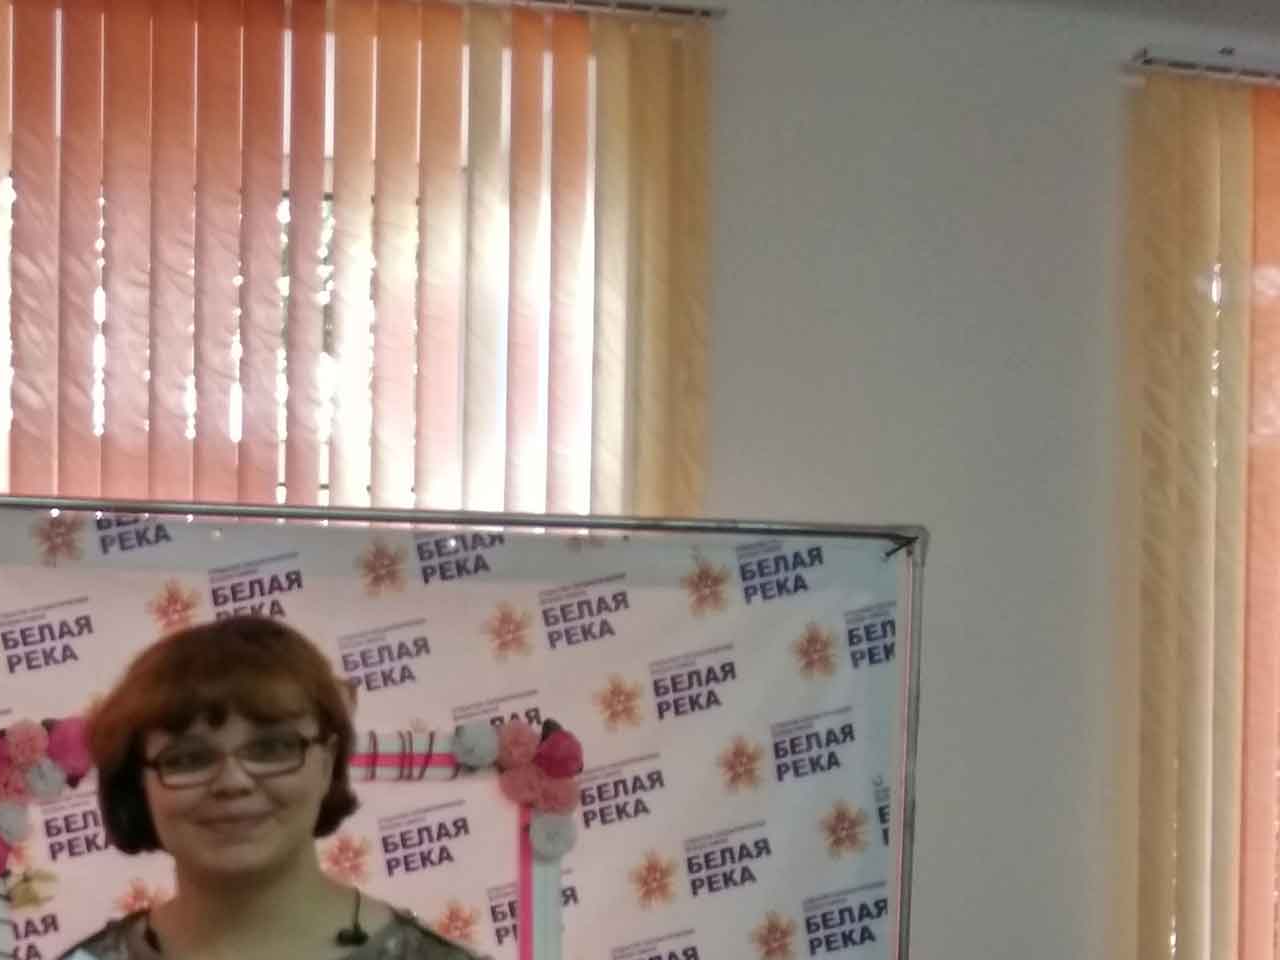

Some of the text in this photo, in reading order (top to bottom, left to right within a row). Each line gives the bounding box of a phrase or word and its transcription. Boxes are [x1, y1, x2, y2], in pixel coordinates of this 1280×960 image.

[101, 523, 172, 555] РЕКА
[422, 553, 491, 585] РЕКА
[738, 545, 824, 583] БЕЛАЯ
[211, 569, 304, 607] БЕЛАЯ
[743, 574, 809, 604] РЕКА
[541, 591, 630, 628] БЕЛАЯ
[0, 614, 95, 652] БЕЛАЯ
[546, 620, 616, 649] РЕКА
[847, 616, 897, 648] БЕЛ
[7, 641, 80, 674] РЕКА
[342, 636, 432, 674] БЕЛАЯ
[851, 640, 897, 669] РЕК
[348, 665, 417, 693] РЕКА
[652, 661, 737, 698] БЕЛАЯ
[656, 689, 723, 719] РЕКА
[772, 723, 856, 760] БЕЛАЯ
[776, 751, 841, 781] РЕКА
[580, 770, 665, 807] БЕЛАЯ
[45, 810, 99, 838] БЕЛ
[582, 798, 651, 828] РЕКА
[382, 816, 471, 856] БЕЛАЯ
[386, 846, 454, 877] РЕКА
[687, 838, 773, 875] БЕЛАЯ
[691, 866, 758, 897] РЕКА
[805, 898, 889, 935] БЕЛАЯ
[809, 925, 877, 957] РЕКА
